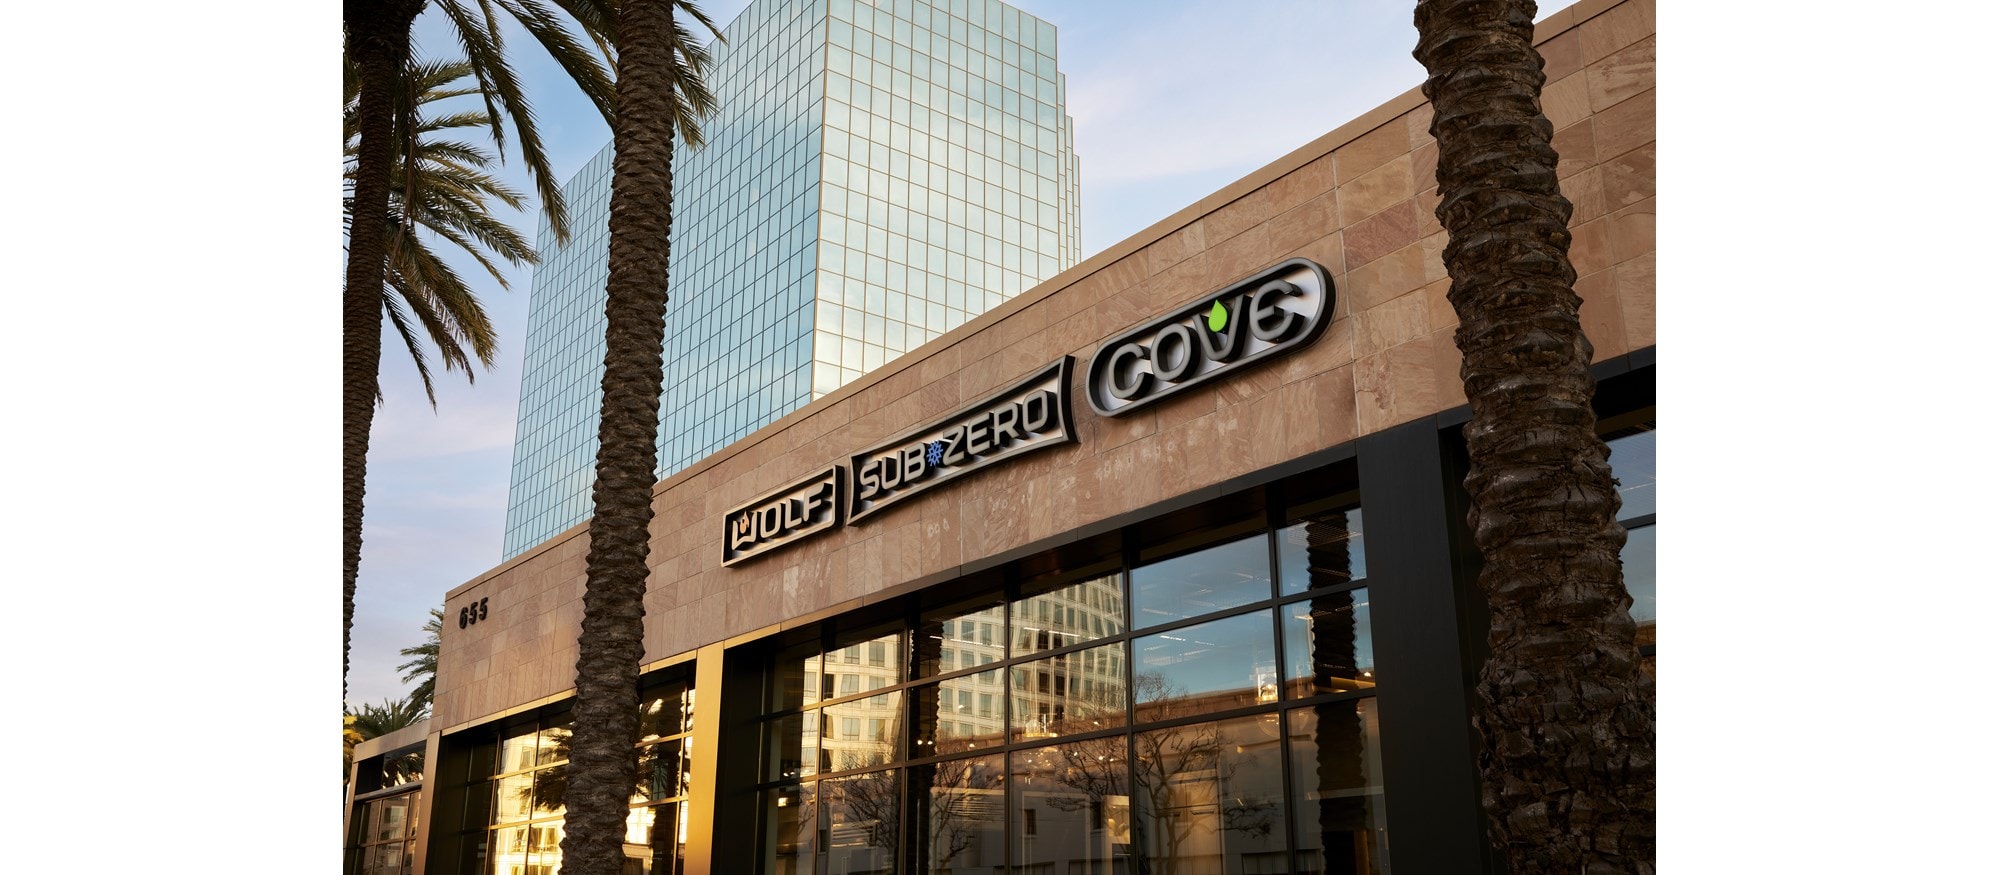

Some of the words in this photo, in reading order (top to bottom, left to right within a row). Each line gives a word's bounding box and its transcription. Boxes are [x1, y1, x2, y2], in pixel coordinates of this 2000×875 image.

[1108, 279, 1303, 400] COVE
[731, 482, 826, 551] WOLF
[459, 596, 489, 629] 655
